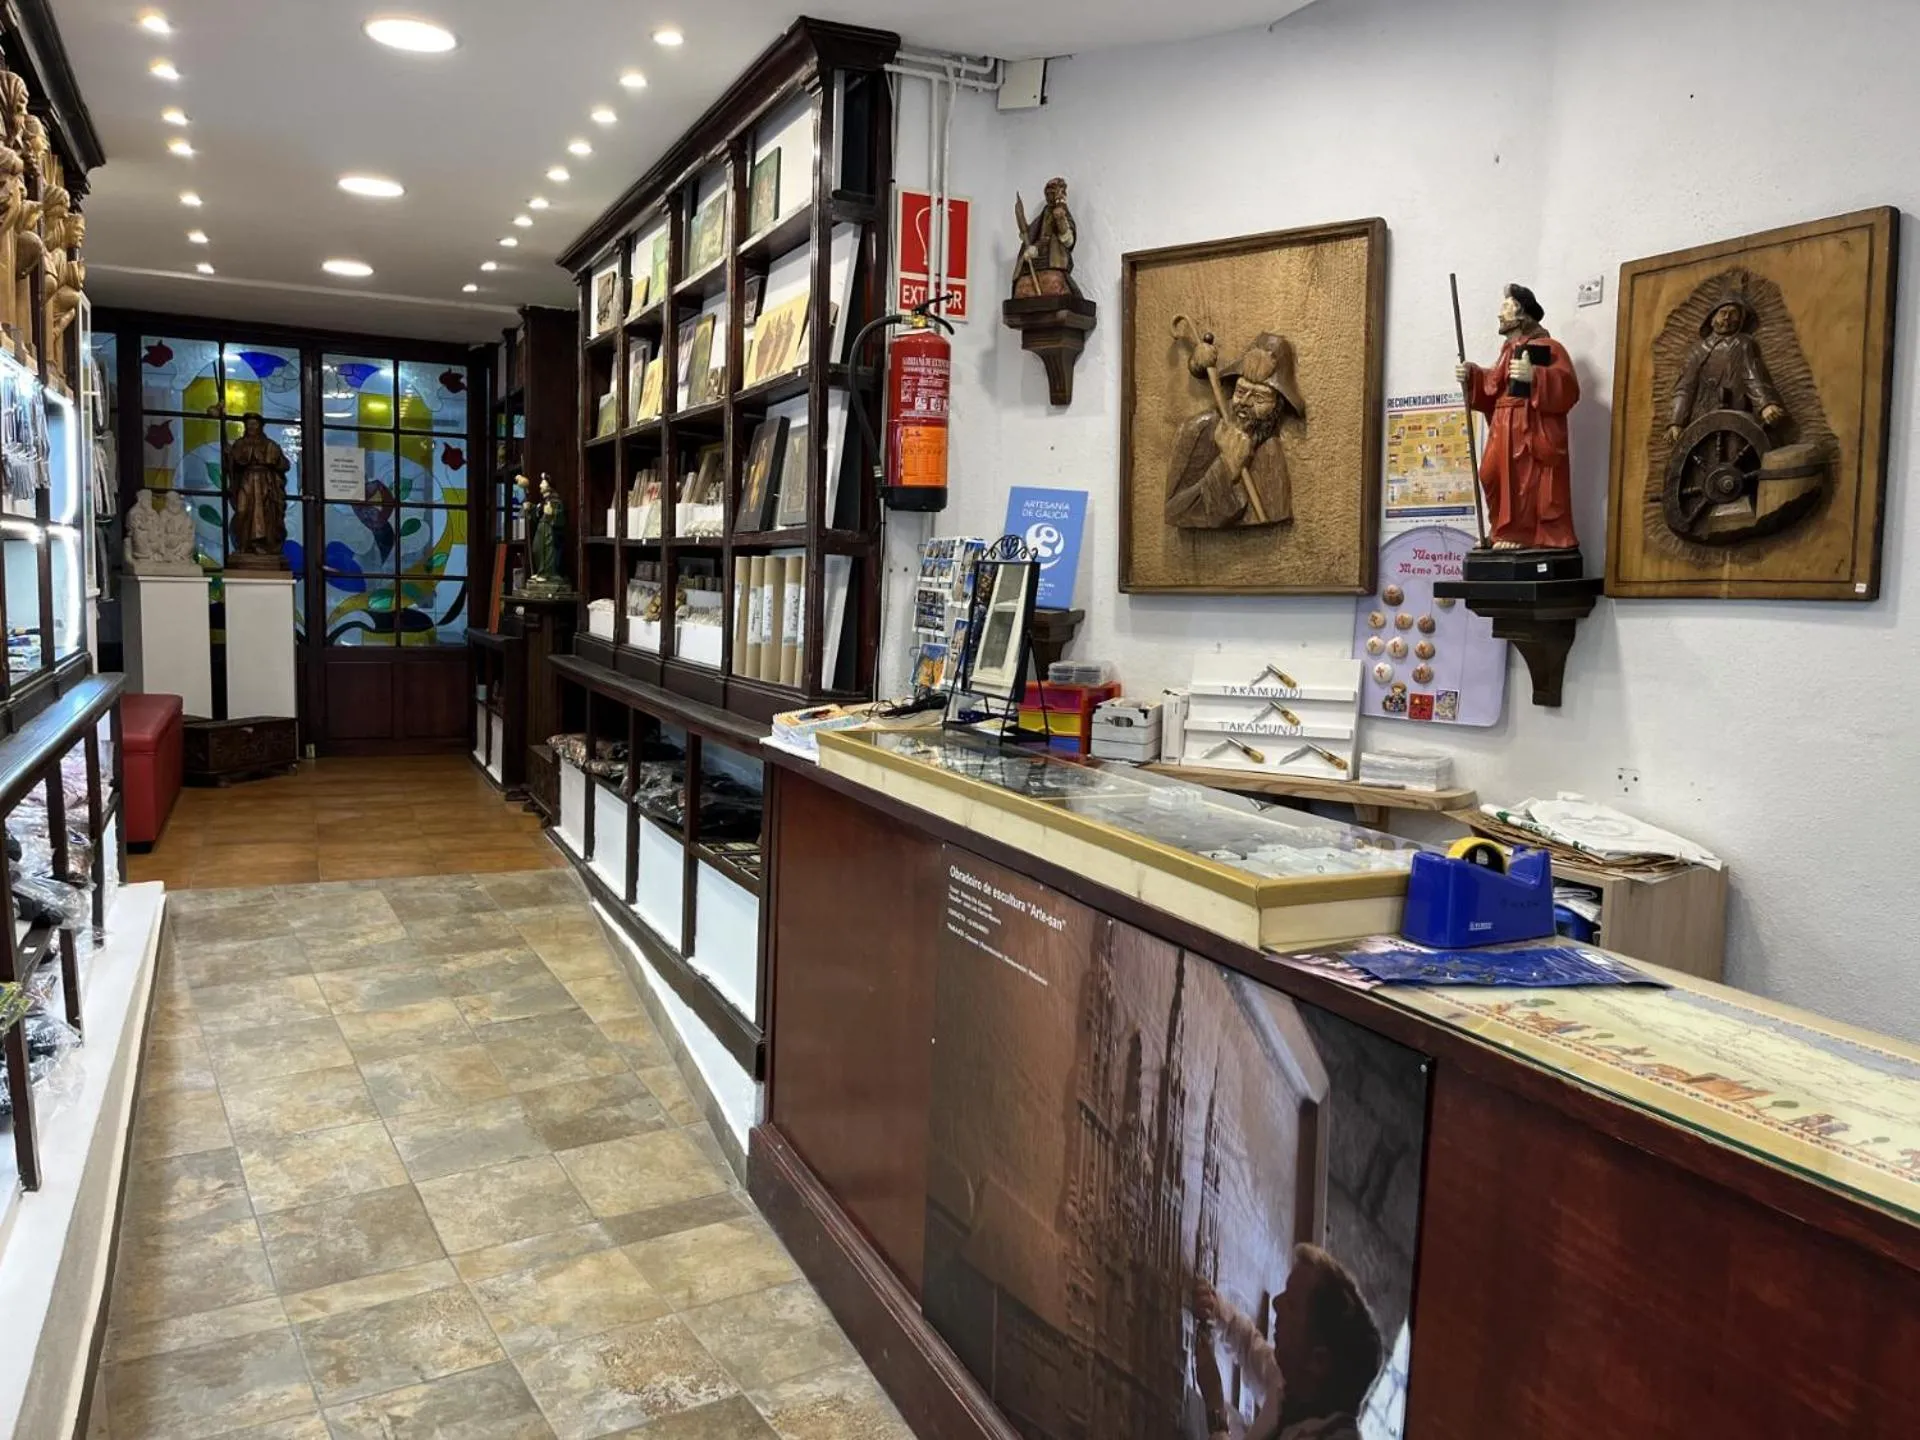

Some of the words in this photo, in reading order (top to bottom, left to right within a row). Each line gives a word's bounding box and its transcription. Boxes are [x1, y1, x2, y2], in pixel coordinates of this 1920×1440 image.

[902, 284, 962, 309] EXTOR
[1022, 509, 1034, 517] DE
[1035, 510, 1069, 519] GALICIA
[1412, 548, 1462, 562] Magnetic
[1399, 562, 1432, 575] Memo
[1433, 564, 1463, 576] Hold
[983, 880, 992, 896] de
[992, 887, 1026, 913] escultura
